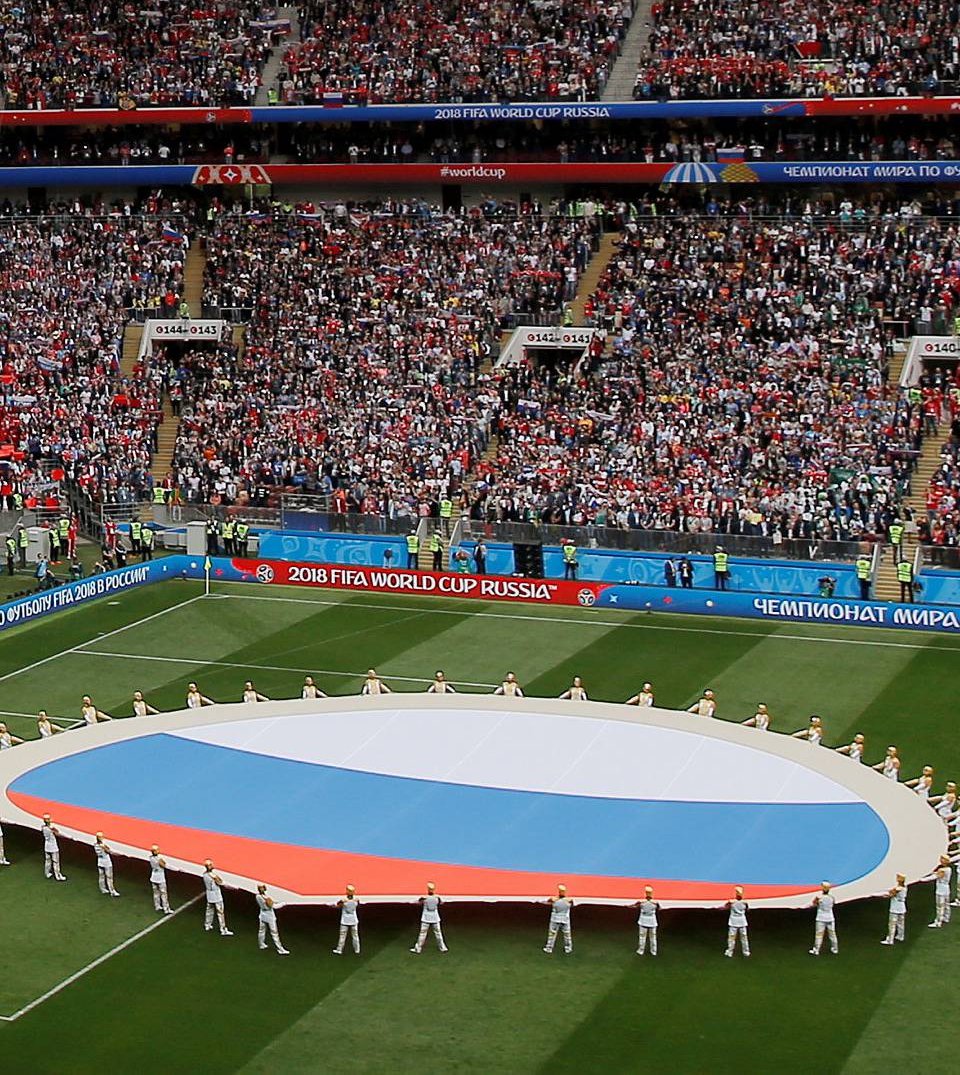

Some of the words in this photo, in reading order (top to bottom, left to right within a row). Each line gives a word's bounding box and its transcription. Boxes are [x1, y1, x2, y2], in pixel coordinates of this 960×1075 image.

[435, 109, 461, 119] 2018
[463, 108, 488, 118] FIFA
[491, 108, 533, 118] WORLD
[535, 107, 560, 118] CUP
[440, 166, 506, 179] #worldcup
[783, 166, 869, 177] ЧЕМПИОНАТ
[873, 166, 916, 177] МИРА
[919, 165, 940, 177] ПО
[288, 566, 328, 583] 2018
[331, 569, 368, 586] FIFA
[370, 572, 436, 590] WORLD
[439, 576, 477, 593] CUP
[7, 594, 52, 622] ФУТБОЛУ
[53, 587, 74, 607] FIFA
[75, 582, 96, 602] 2018
[97, 578, 105, 594] В
[754, 598, 888, 623] ЧЕМПИОНАТ
[894, 609, 960, 628] МИРА
